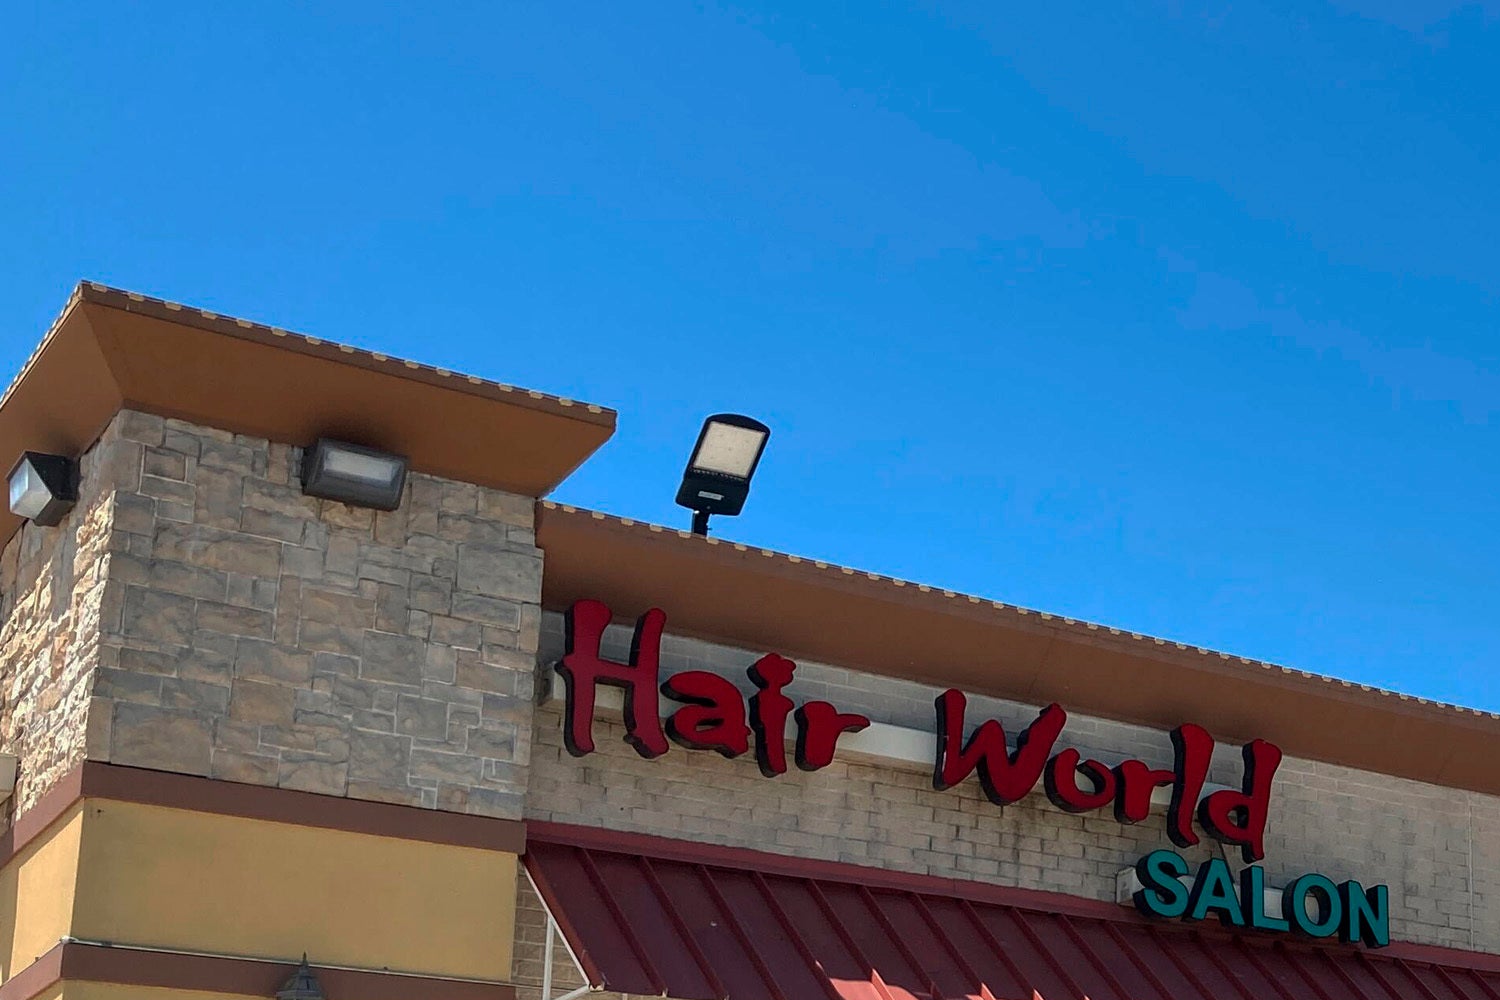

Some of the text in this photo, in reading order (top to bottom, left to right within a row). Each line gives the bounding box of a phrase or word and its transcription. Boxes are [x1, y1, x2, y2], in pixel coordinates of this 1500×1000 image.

[555, 600, 1282, 862] Hair World
[1135, 849, 1389, 949] SALON
